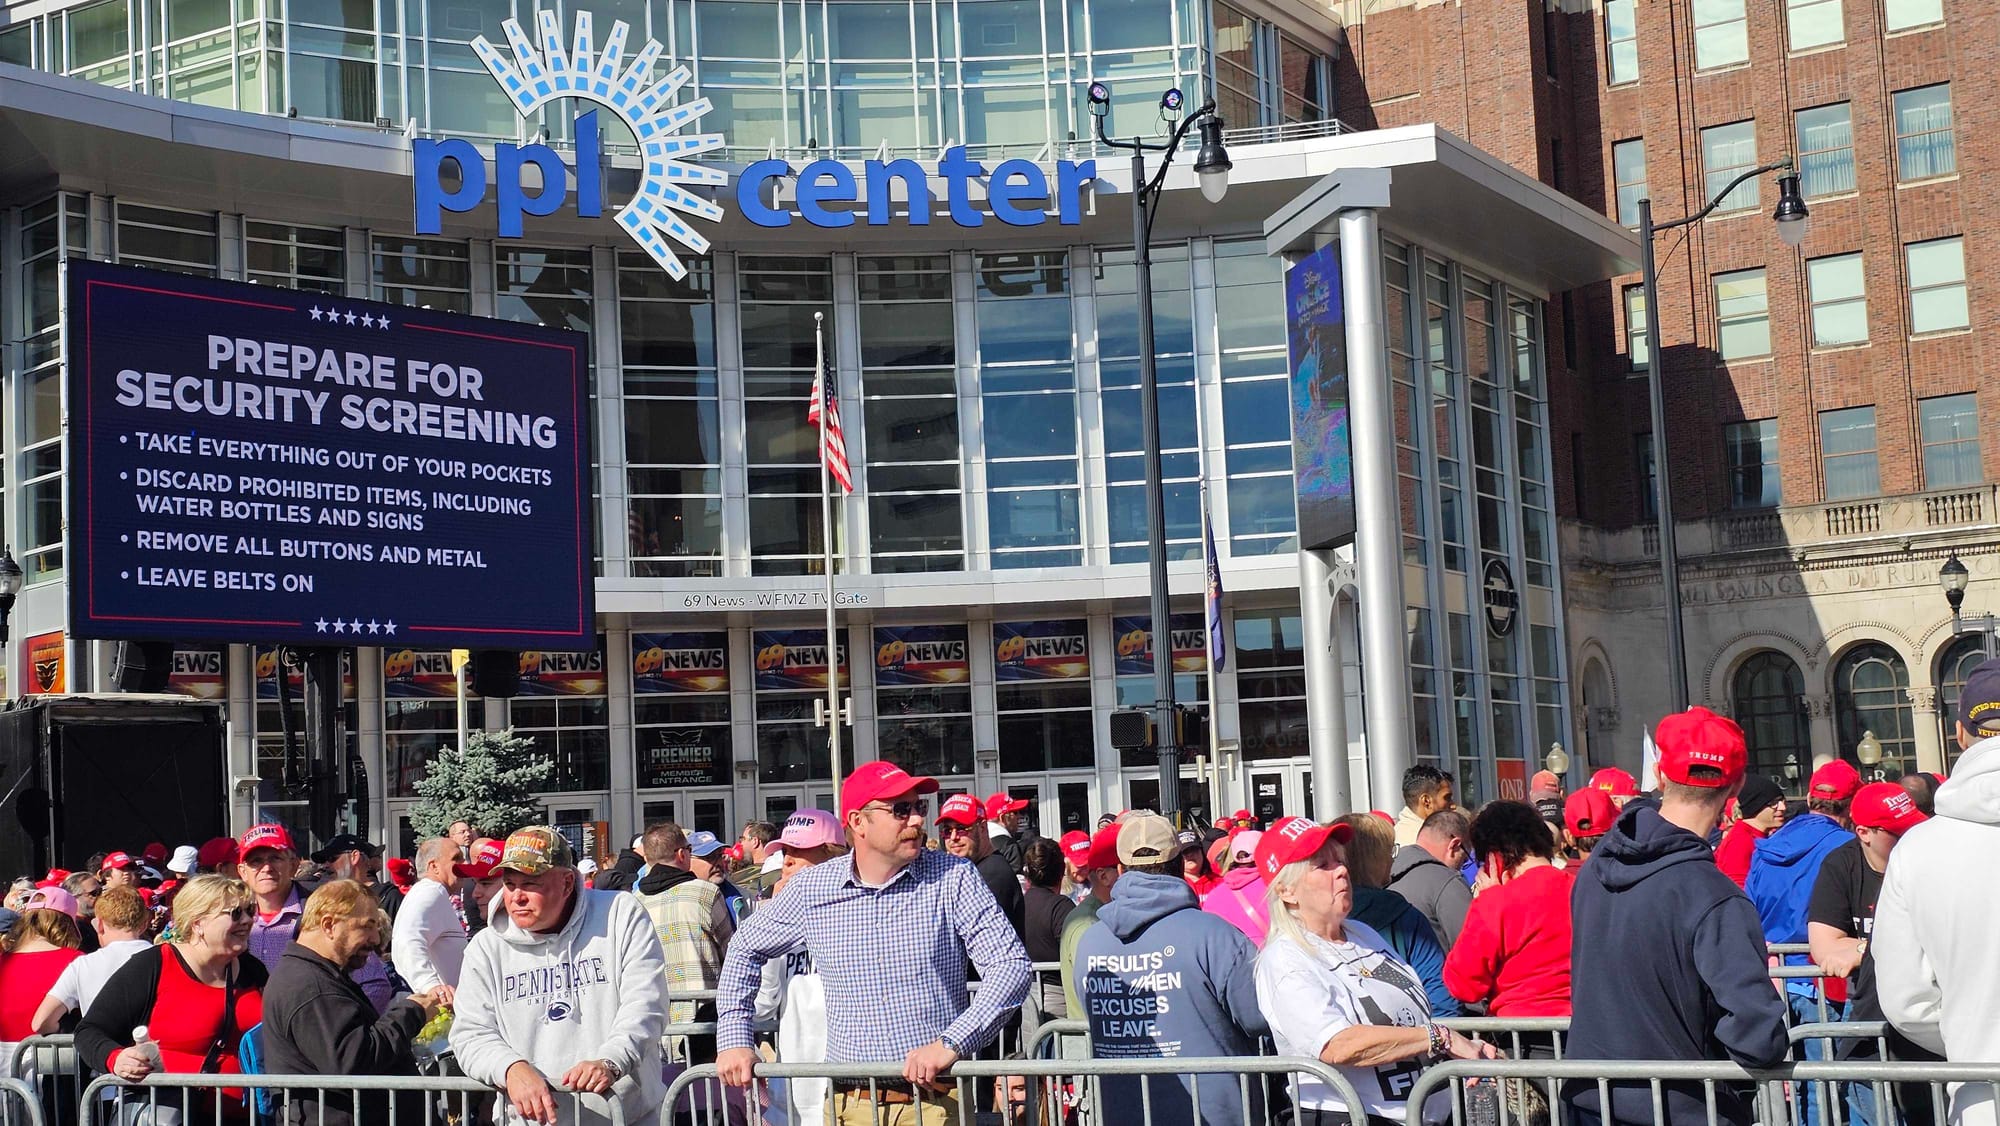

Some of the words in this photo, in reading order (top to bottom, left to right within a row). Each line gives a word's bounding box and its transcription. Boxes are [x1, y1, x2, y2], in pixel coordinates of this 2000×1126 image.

[413, 110, 600, 238] ppl
[736, 144, 1097, 228] center
[208, 334, 396, 391] PREPARE
[407, 359, 484, 401] FOR
[115, 369, 330, 425] SECURITY
[340, 394, 557, 449] SCREENING
[135, 431, 192, 454] TAKE
[198, 437, 330, 466] EVERYTHING
[335, 448, 377, 470] OUT
[382, 454, 409, 473] OF
[415, 457, 466, 479] YOUR
[471, 462, 552, 486] POCKETS
[136, 468, 232, 493] DISCARD
[239, 476, 361, 503] PROHIBITED
[366, 486, 427, 511] ITEMS,
[432, 491, 531, 516] INCLUDING
[136, 494, 213, 517] WATER
[220, 500, 312, 524] BOTTLES
[317, 507, 361, 526] AND
[367, 510, 424, 531] SIGNS
[137, 530, 228, 553] REMOVE
[234, 536, 274, 556] ALL
[280, 539, 374, 562] BUTTONS
[379, 545, 421, 564] AND
[427, 548, 487, 568] METAL
[137, 566, 207, 588] LEAVE
[214, 570, 276, 591] BELTS
[282, 574, 313, 593] ON
[684, 594, 701, 607] 69
[706, 594, 745, 607] News
[757, 592, 808, 606] WFMZ
[835, 591, 869, 604] Gate
[877, 640, 905, 667] 69
[906, 642, 964, 661] NEWS
[997, 635, 1025, 661] 69
[1026, 637, 1084, 657] NEWS
[1118, 629, 1145, 656] 69
[1146, 631, 1204, 651] WS
[172, 653, 220, 673] EWS
[386, 649, 414, 677] 69
[541, 652, 600, 671] NEWS
[635, 647, 663, 673] 69
[664, 650, 723, 669] NEWS
[757, 643, 785, 670] 69
[785, 646, 844, 666] NEWS
[1969, 702, 1990, 719] UNITED
[651, 747, 712, 763] PREMIER
[1689, 751, 1725, 762] TRUMP
[652, 776, 713, 784] ENTRANCE
[1280, 817, 1318, 841] TRU
[1266, 854, 1280, 873] 47
[785, 949, 818, 979] PEN
[505, 967, 554, 1002] PENN
[555, 957, 606, 990] STATE
[1082, 975, 1123, 994] COME
[1128, 970, 1182, 996] WHEN
[1091, 995, 1170, 1017] EXCUSES
[1102, 1019, 1162, 1038] LEAVE.
